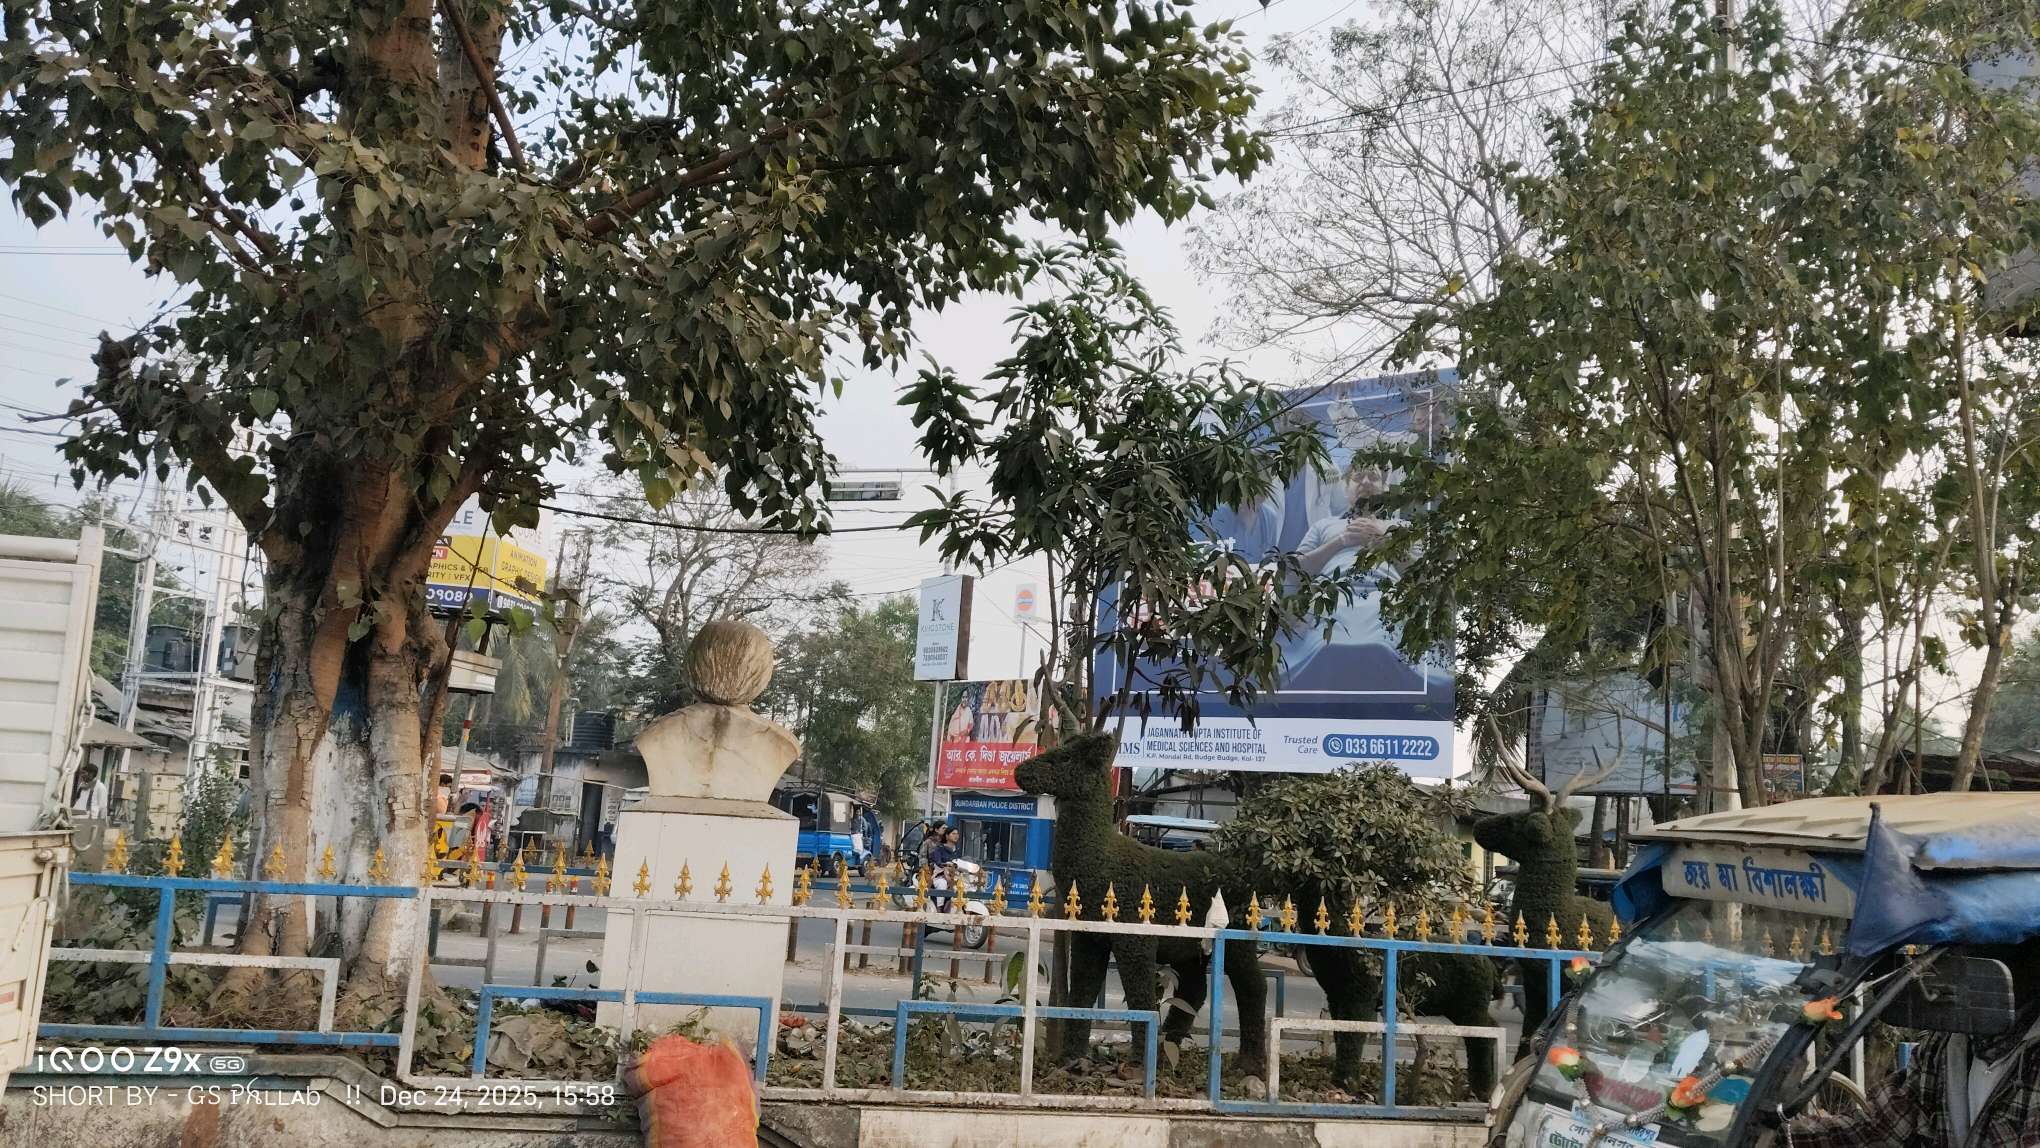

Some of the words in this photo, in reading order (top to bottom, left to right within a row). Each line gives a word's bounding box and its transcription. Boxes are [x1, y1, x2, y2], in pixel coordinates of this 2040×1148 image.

[454, 573, 471, 581] VFX
[931, 598, 945, 621] K
[1214, 728, 1251, 739] INSTITUTE
[1253, 728, 1262, 740] OF
[1283, 736, 1318, 744] Trusted
[1147, 741, 1176, 751] MEDICAL
[1179, 741, 1212, 753] SCIENCES
[1215, 742, 1230, 753] AND
[1232, 742, 1267, 754] HOSPITAL
[1298, 745, 1318, 754] Care
[1345, 738, 1367, 754] 033
[1370, 739, 1398, 755] 6611
[1402, 739, 1432, 756] 2222
[954, 799, 987, 808] SUNDARBAN
[988, 801, 1008, 809] POLICE
[1009, 801, 1034, 811] DISTRICT
[1682, 861, 1710, 890] জয়
[1716, 863, 1738, 891] মা
